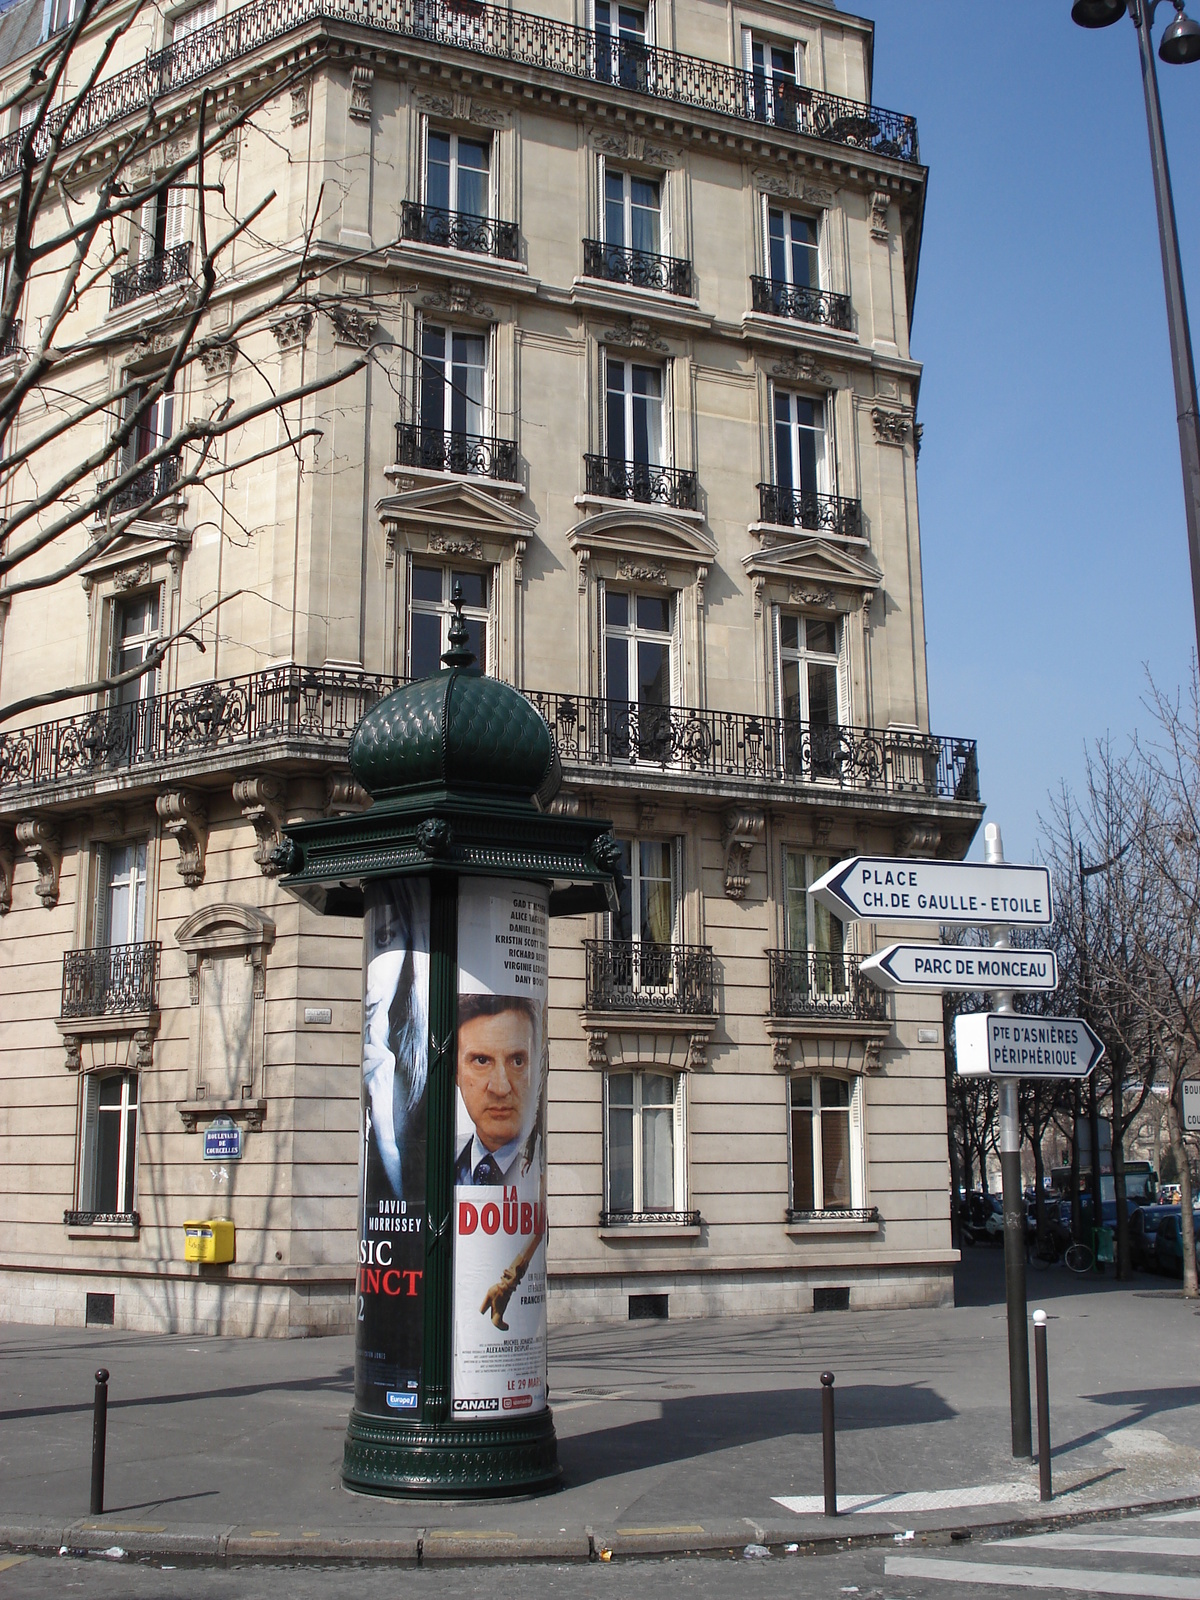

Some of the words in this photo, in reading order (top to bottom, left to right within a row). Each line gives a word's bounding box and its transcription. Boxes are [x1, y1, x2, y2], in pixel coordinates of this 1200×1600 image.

[862, 869, 918, 887] PLACE
[513, 899, 526, 908] GAD
[917, 894, 978, 911] GAULLE
[991, 897, 1042, 914] ETOILE
[510, 911, 528, 921] ALICE
[509, 923, 531, 935] DANIEL
[495, 935, 523, 945] KRISTIN
[524, 938, 539, 948] SCOTT
[508, 949, 534, 960] RICHARD
[504, 961, 532, 972] VIRGINIE
[914, 957, 952, 975] PARC
[956, 960, 974, 976] DE
[978, 961, 1047, 978] MONCEAU
[994, 1045, 1077, 1066] PÉRIPHÉRIQUE
[1184, 1085, 1200, 1095] BOU
[503, 1185, 518, 1202] LA
[379, 1200, 407, 1214] DAVID
[368, 1217, 422, 1233] MORRISSEY
[357, 1295, 365, 1321] 2
[486, 1345, 514, 1354] ALEXANDRE
[507, 1380, 516, 1391] LE
[518, 1379, 527, 1390] 29
[453, 1400, 498, 1410] CANAL+
